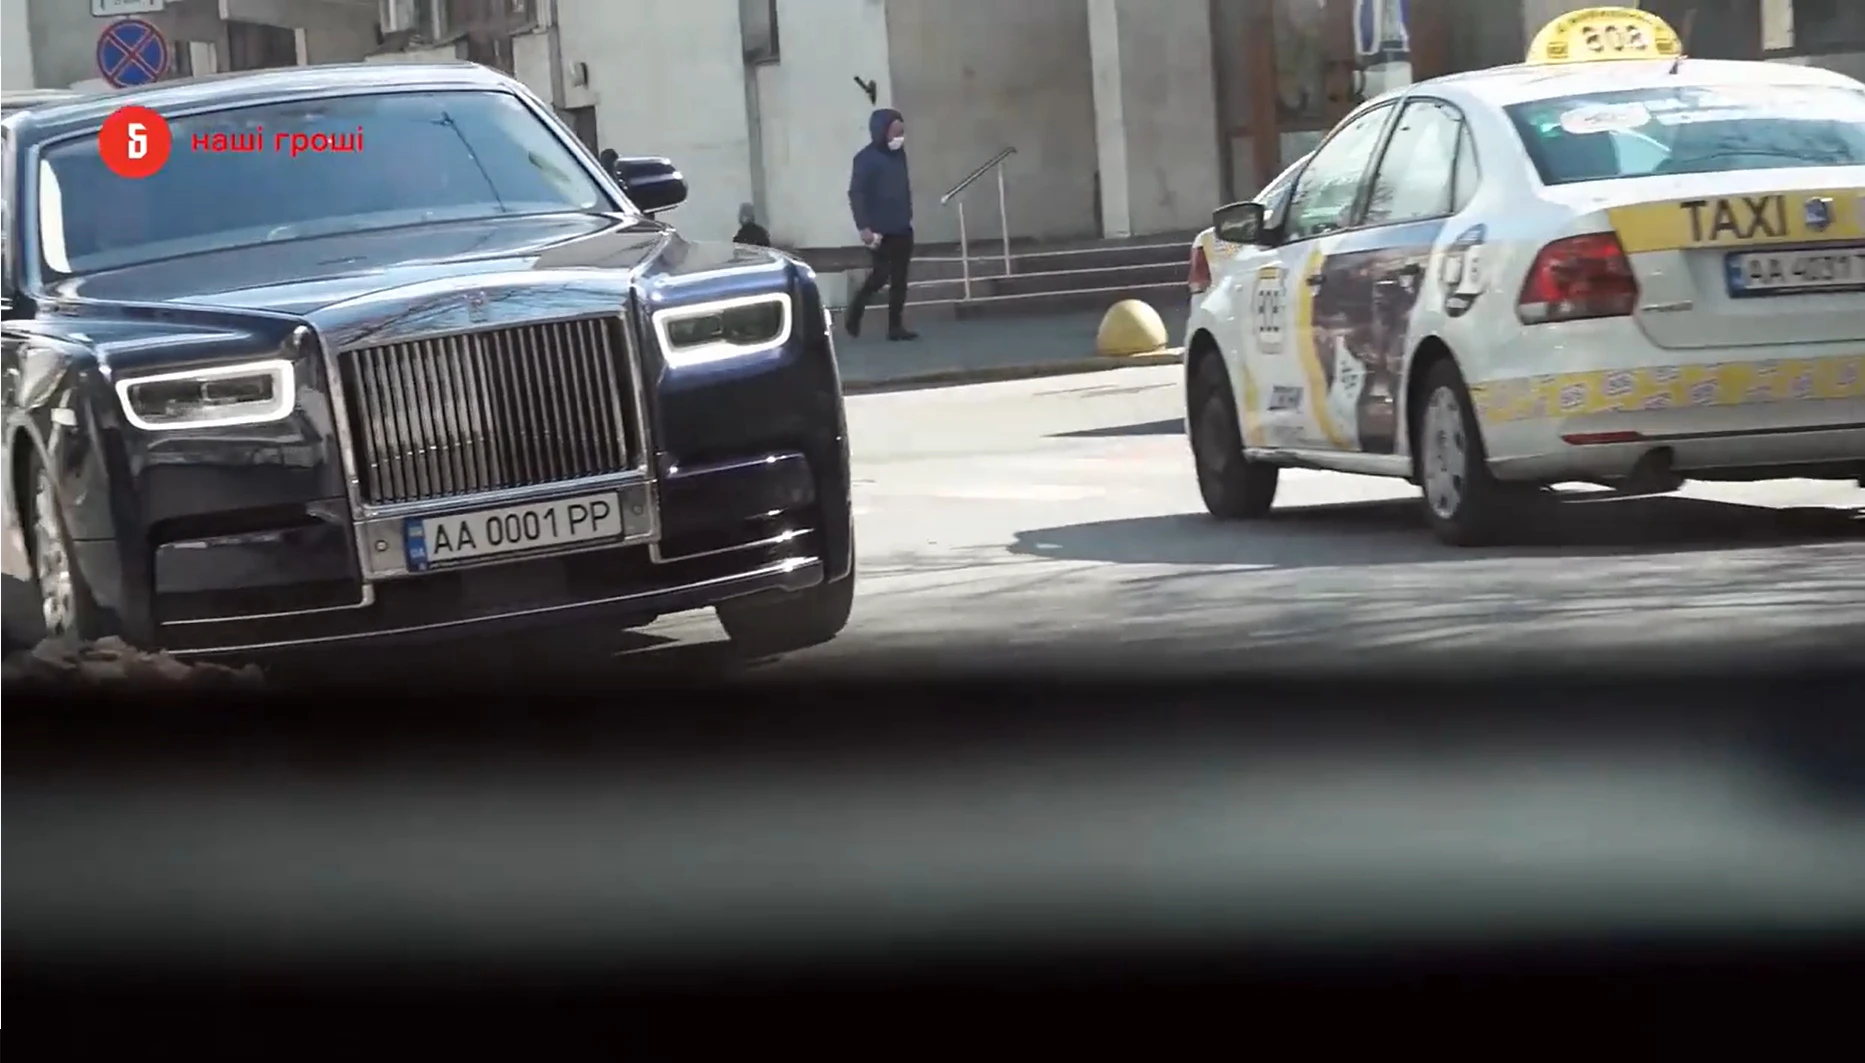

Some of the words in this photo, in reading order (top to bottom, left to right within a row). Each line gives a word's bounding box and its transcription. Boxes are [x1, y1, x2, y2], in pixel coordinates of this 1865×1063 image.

[1680, 194, 1788, 241] TAXI
[434, 521, 476, 554] AA
[485, 507, 558, 546] 0001
[567, 500, 611, 535] PP
